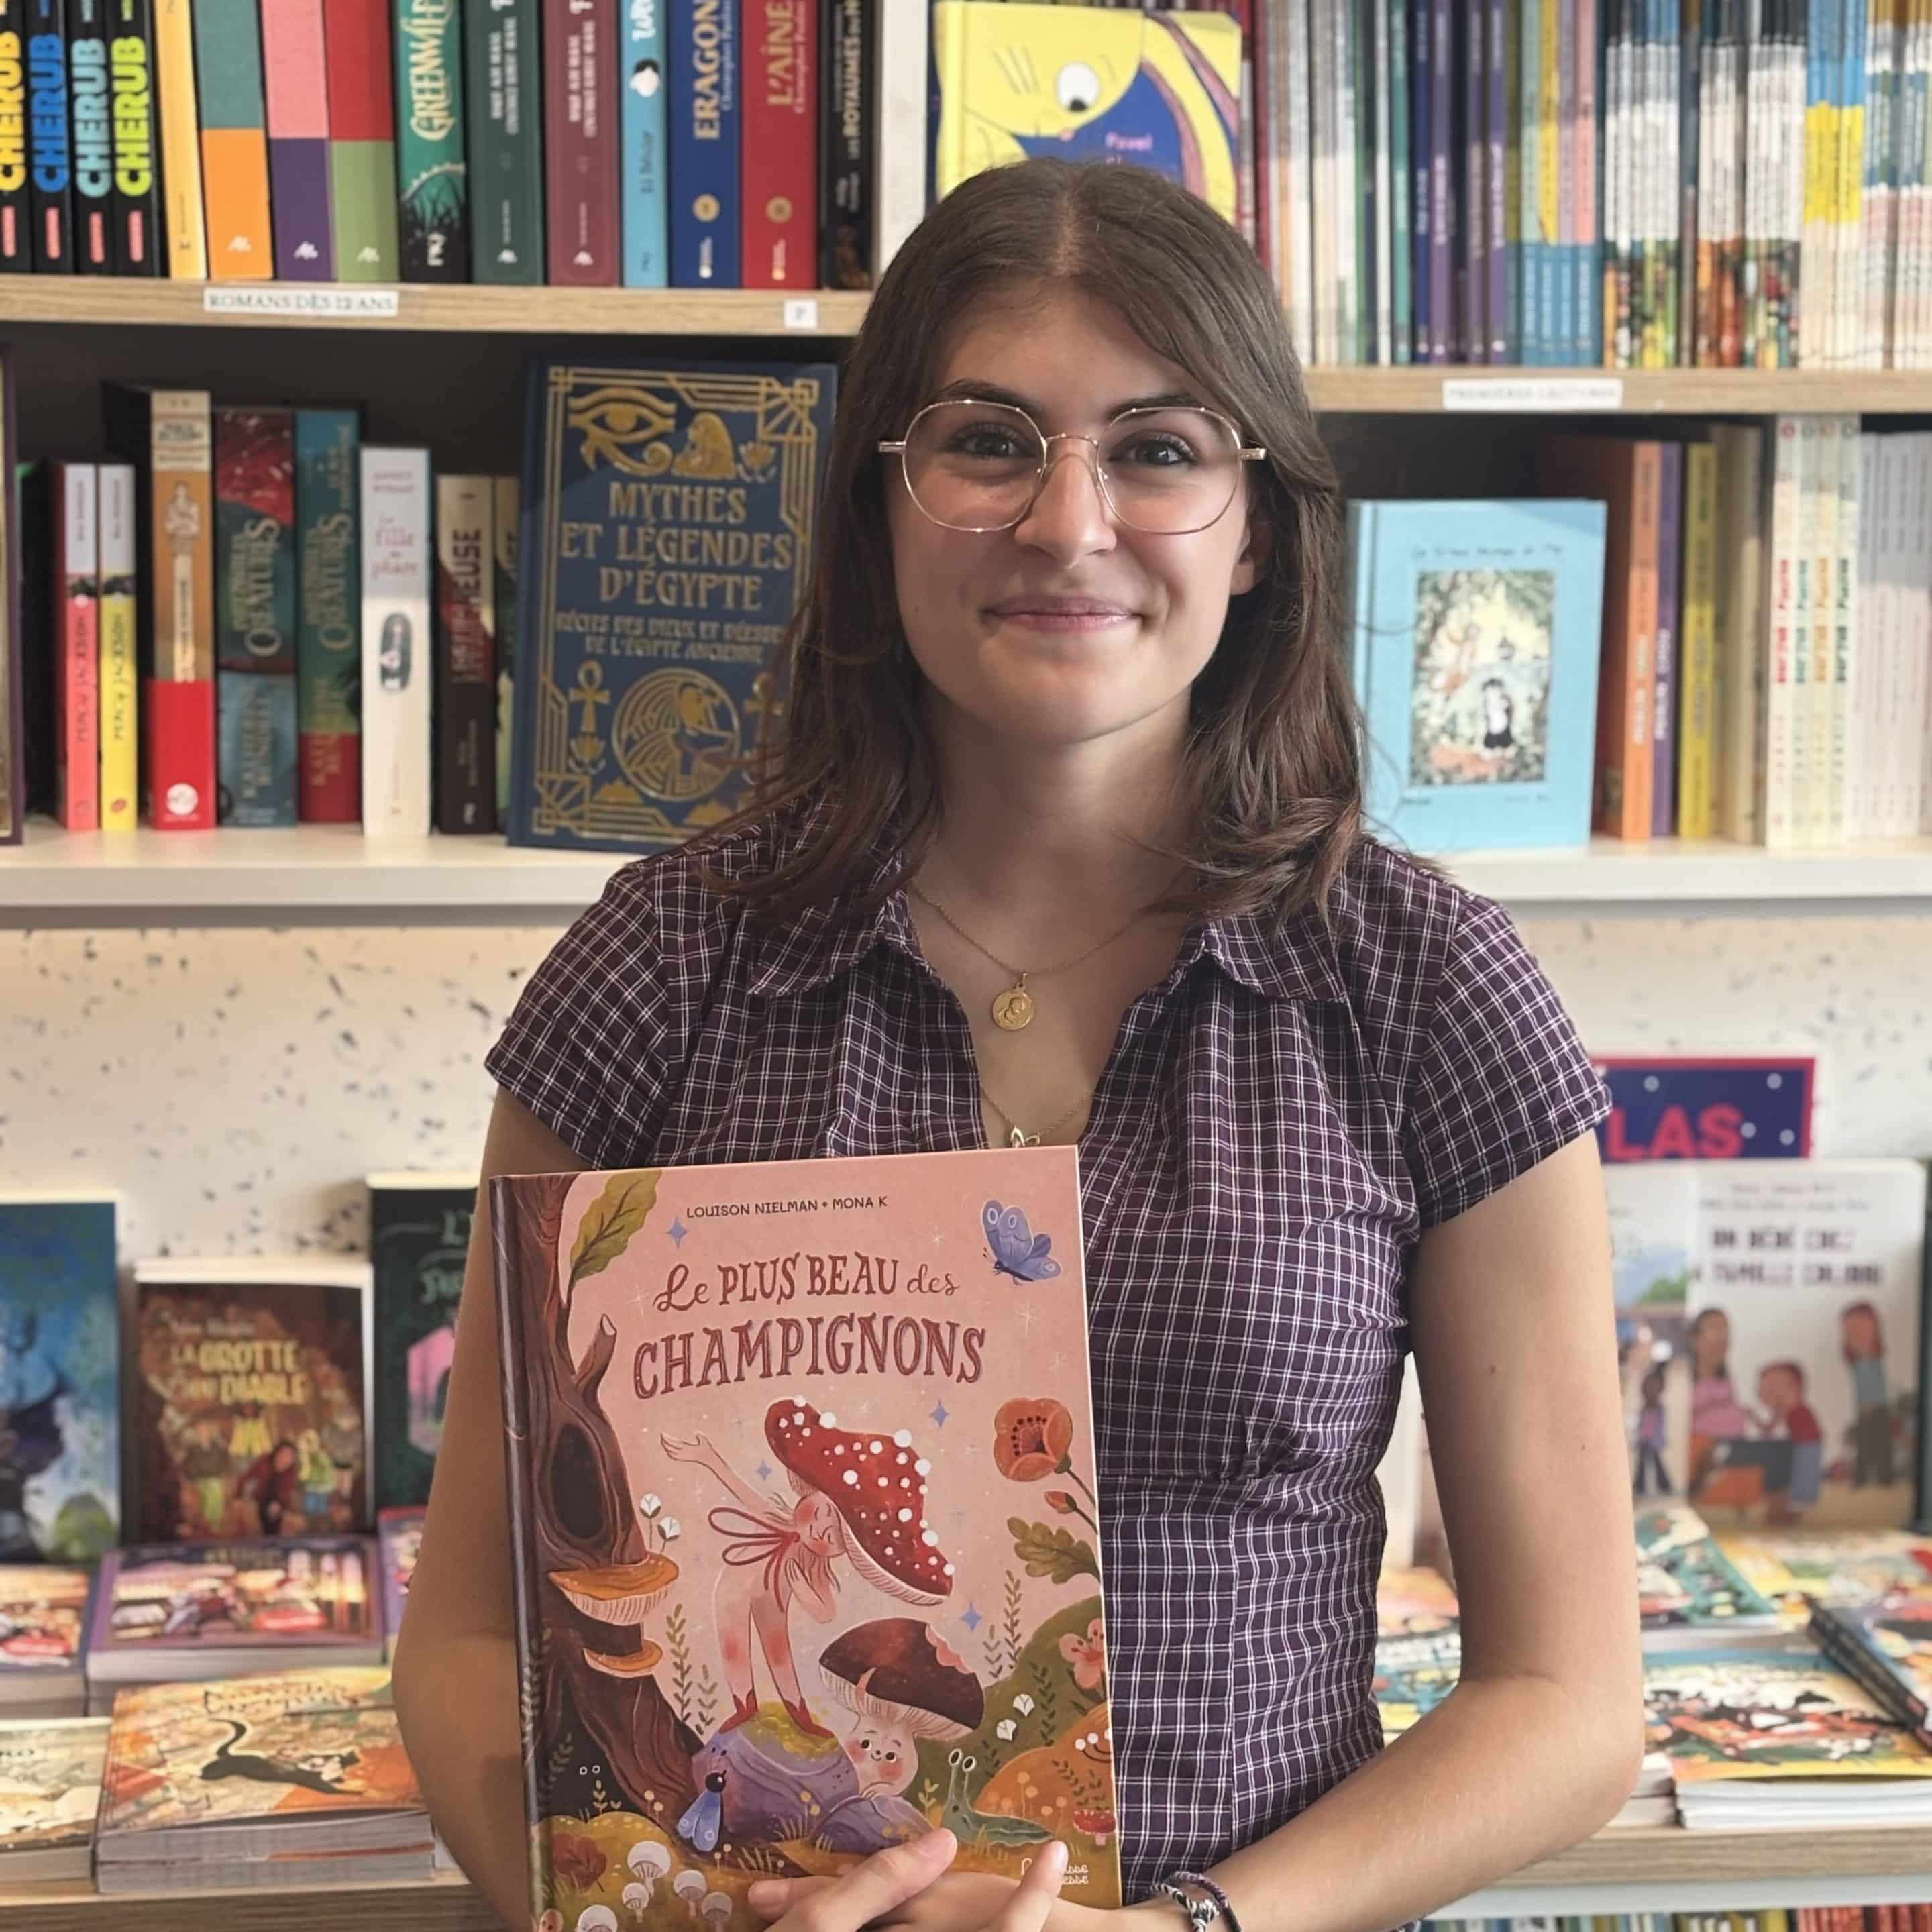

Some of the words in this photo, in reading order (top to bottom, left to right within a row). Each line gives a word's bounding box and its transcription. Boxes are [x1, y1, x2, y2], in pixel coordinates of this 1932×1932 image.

[693, 0, 720, 140] ERAGON
[843, 36, 861, 138] ROYAUMES
[28, 33, 70, 193] CHERUB
[71, 38, 112, 198] CHERUB
[111, 36, 152, 197] CHERUB
[209, 293, 291, 309] ROMANS
[609, 482, 747, 524] MYTHES
[560, 521, 602, 559] ET
[616, 518, 793, 570] LÉGENDES
[599, 562, 763, 612] D'ÉGYPTE
[686, 1203, 750, 1219] LOUISON
[755, 1200, 819, 1215] NIELMAN
[832, 1197, 874, 1210] MONA
[879, 1196, 888, 1208] K
[652, 1263, 710, 1313] Le
[717, 1251, 800, 1307] PLUS
[805, 1250, 900, 1296] BEAU
[906, 1264, 961, 1297] des
[199, 1340, 300, 1373] GROTTE
[633, 1311, 986, 1399] CHAMPIGNONS
[219, 1372, 310, 1406] DIABLE
